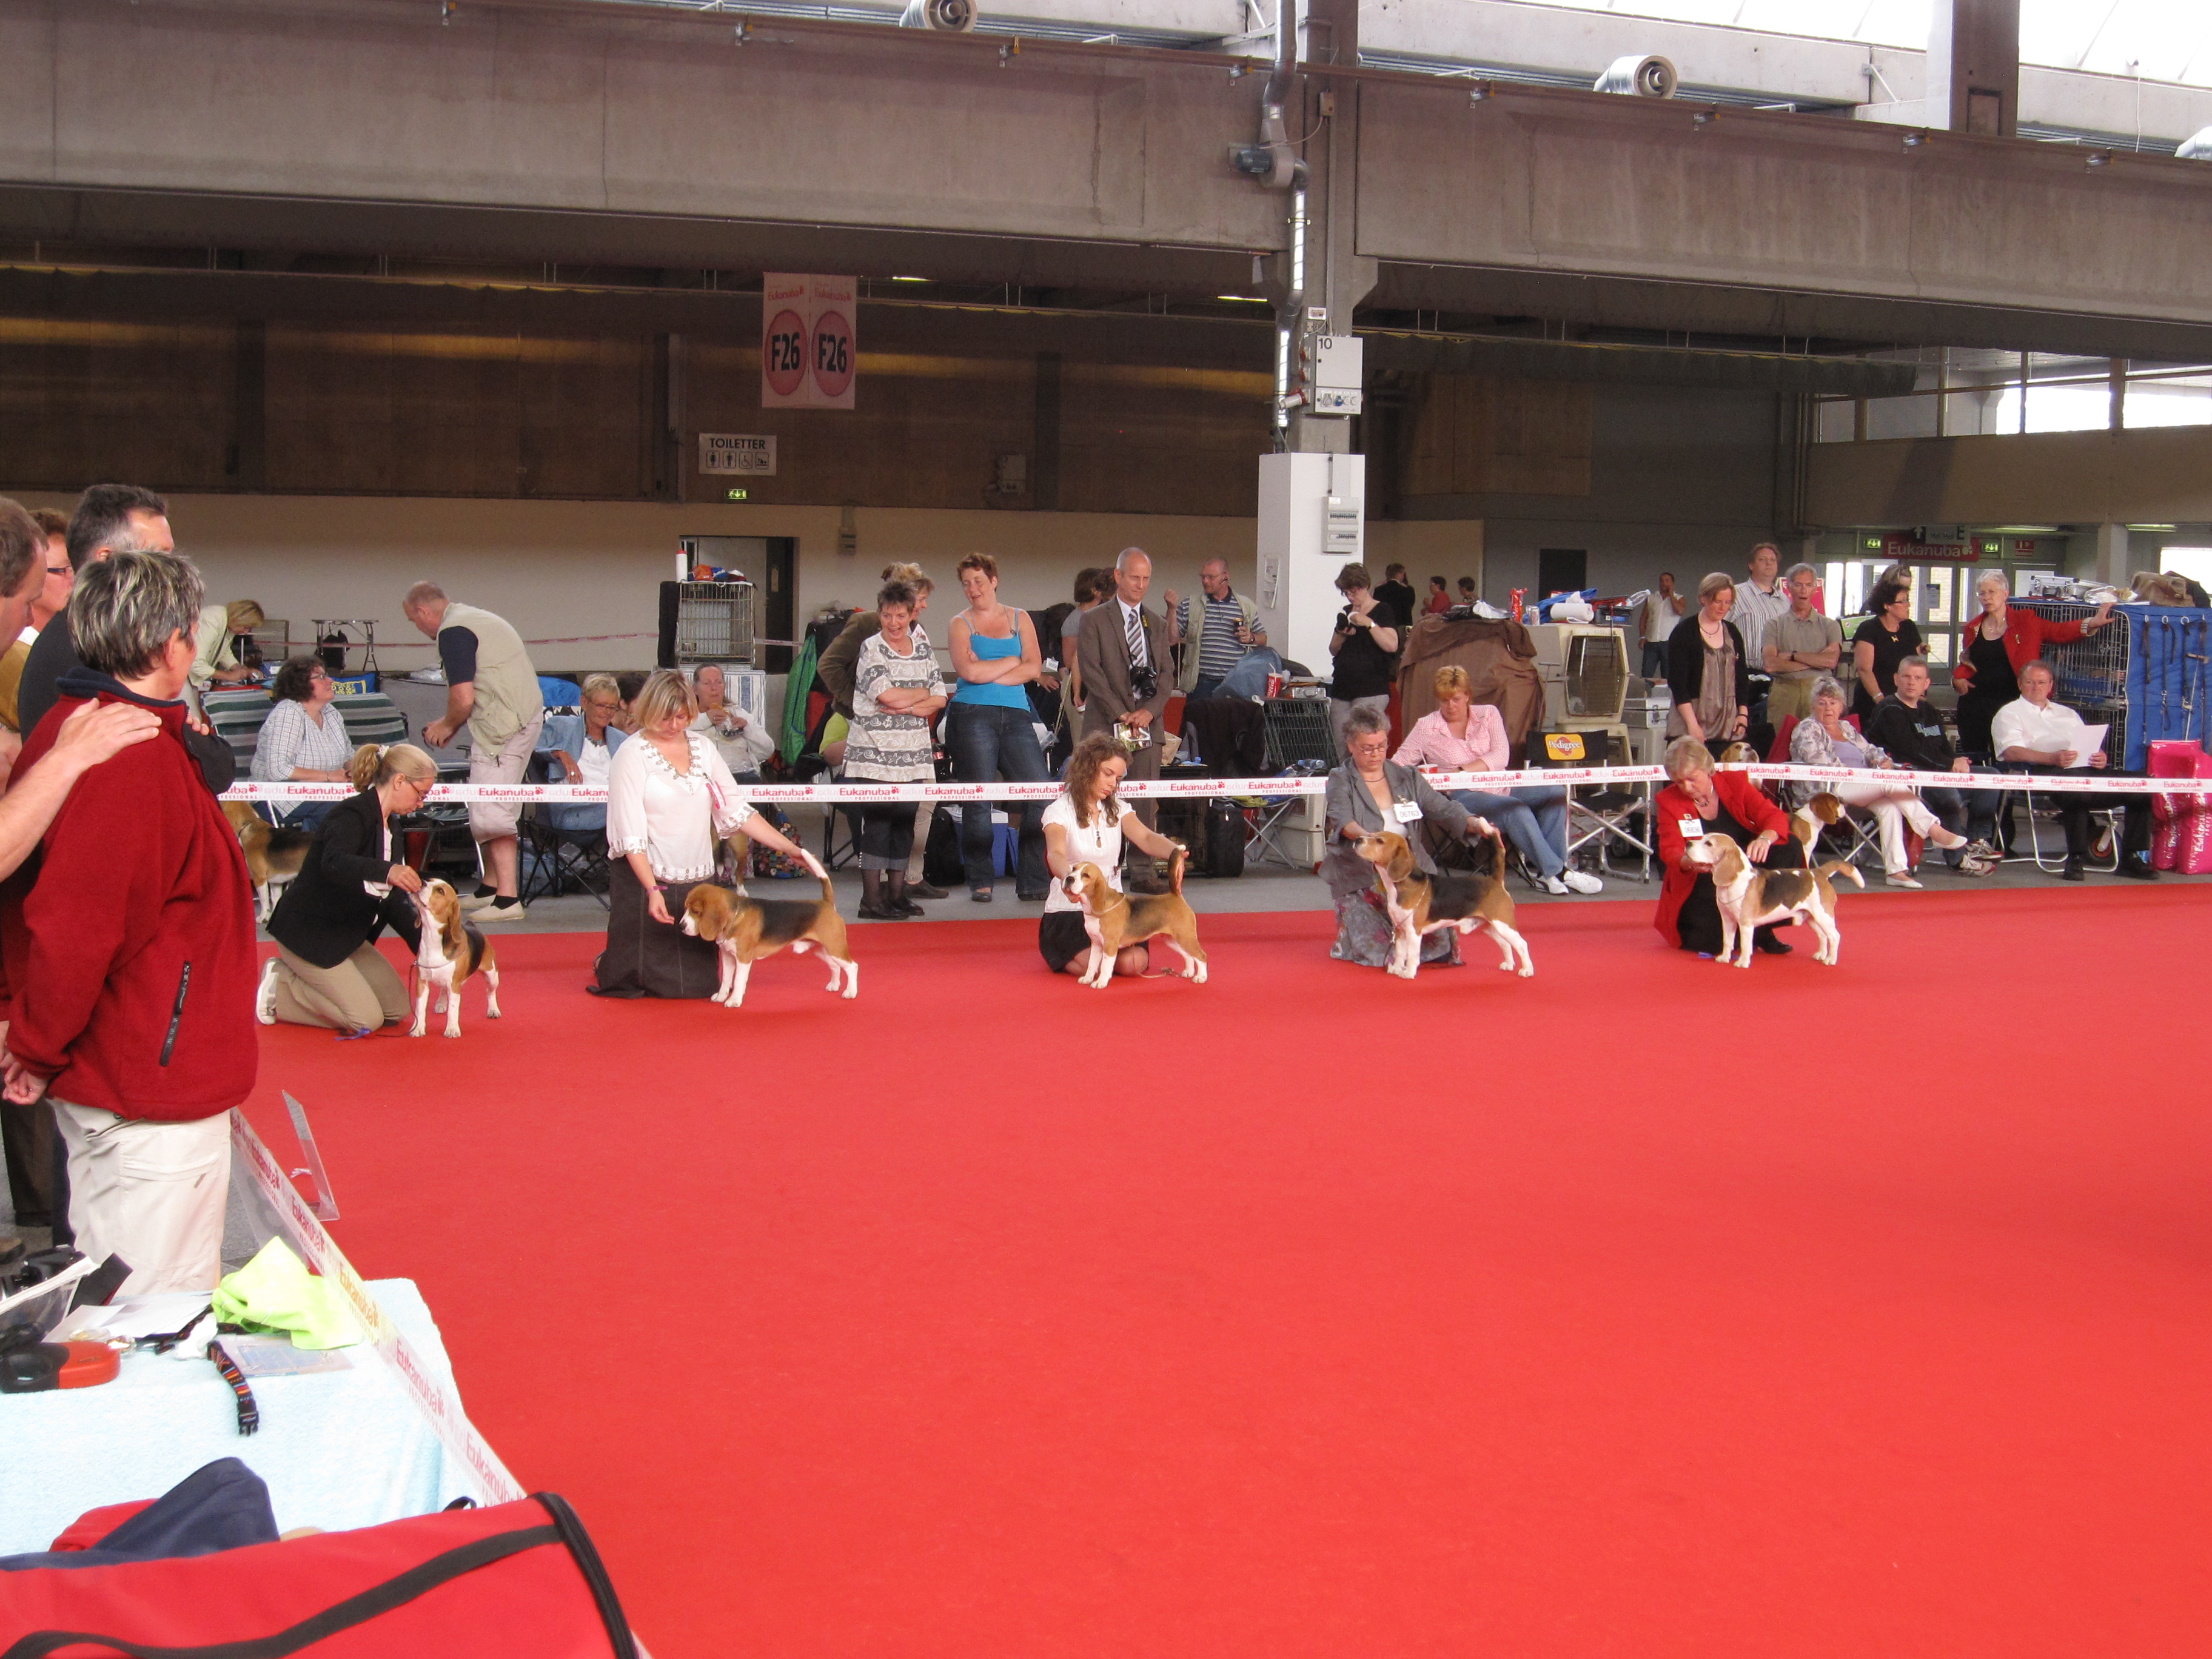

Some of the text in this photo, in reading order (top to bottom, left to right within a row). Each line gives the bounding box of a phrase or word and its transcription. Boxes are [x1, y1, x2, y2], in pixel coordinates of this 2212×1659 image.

[1318, 337, 1333, 350] 10
[772, 332, 800, 372] F26
[819, 334, 847, 374] F26
[709, 438, 765, 449] TOILETTER
[1888, 541, 1960, 557] Eukanuba
[1549, 740, 1581, 751] Pedigree
[287, 785, 345, 794] Eukanuba
[572, 788, 608, 796] Eukan
[925, 786, 975, 795] Eukanuba
[1170, 783, 1218, 791] Eukanuba
[292, 1195, 320, 1253] Eukanuba
[340, 1261, 373, 1327] Eukanuba
[397, 1338, 437, 1412] Eukanuba
[467, 1431, 511, 1504] Eukanub
